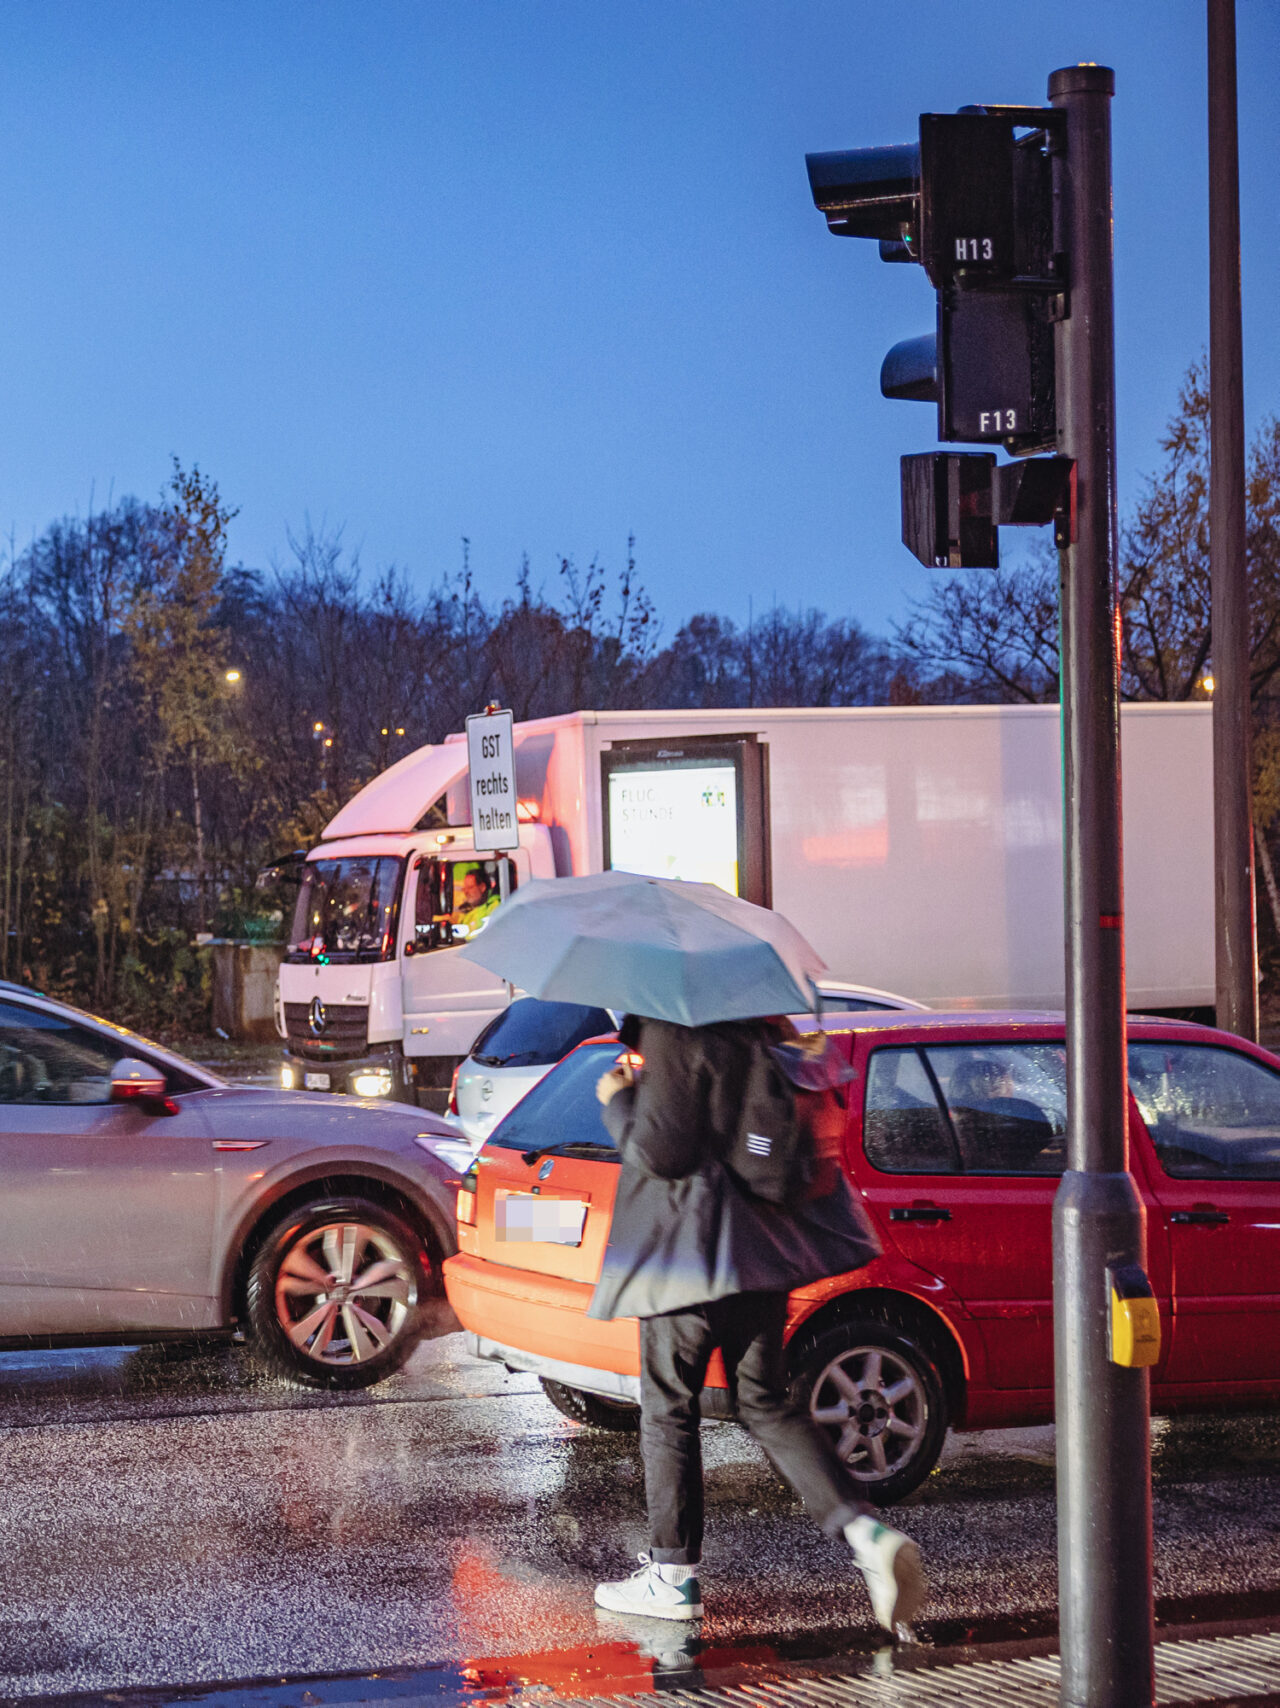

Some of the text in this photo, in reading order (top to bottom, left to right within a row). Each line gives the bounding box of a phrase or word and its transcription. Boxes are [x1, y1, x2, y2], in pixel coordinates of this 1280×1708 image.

[955, 238, 993, 260] H13
[979, 409, 1017, 432] F13
[481, 734, 501, 759] GST
[476, 771, 509, 796] rechts
[478, 807, 512, 831] halten
